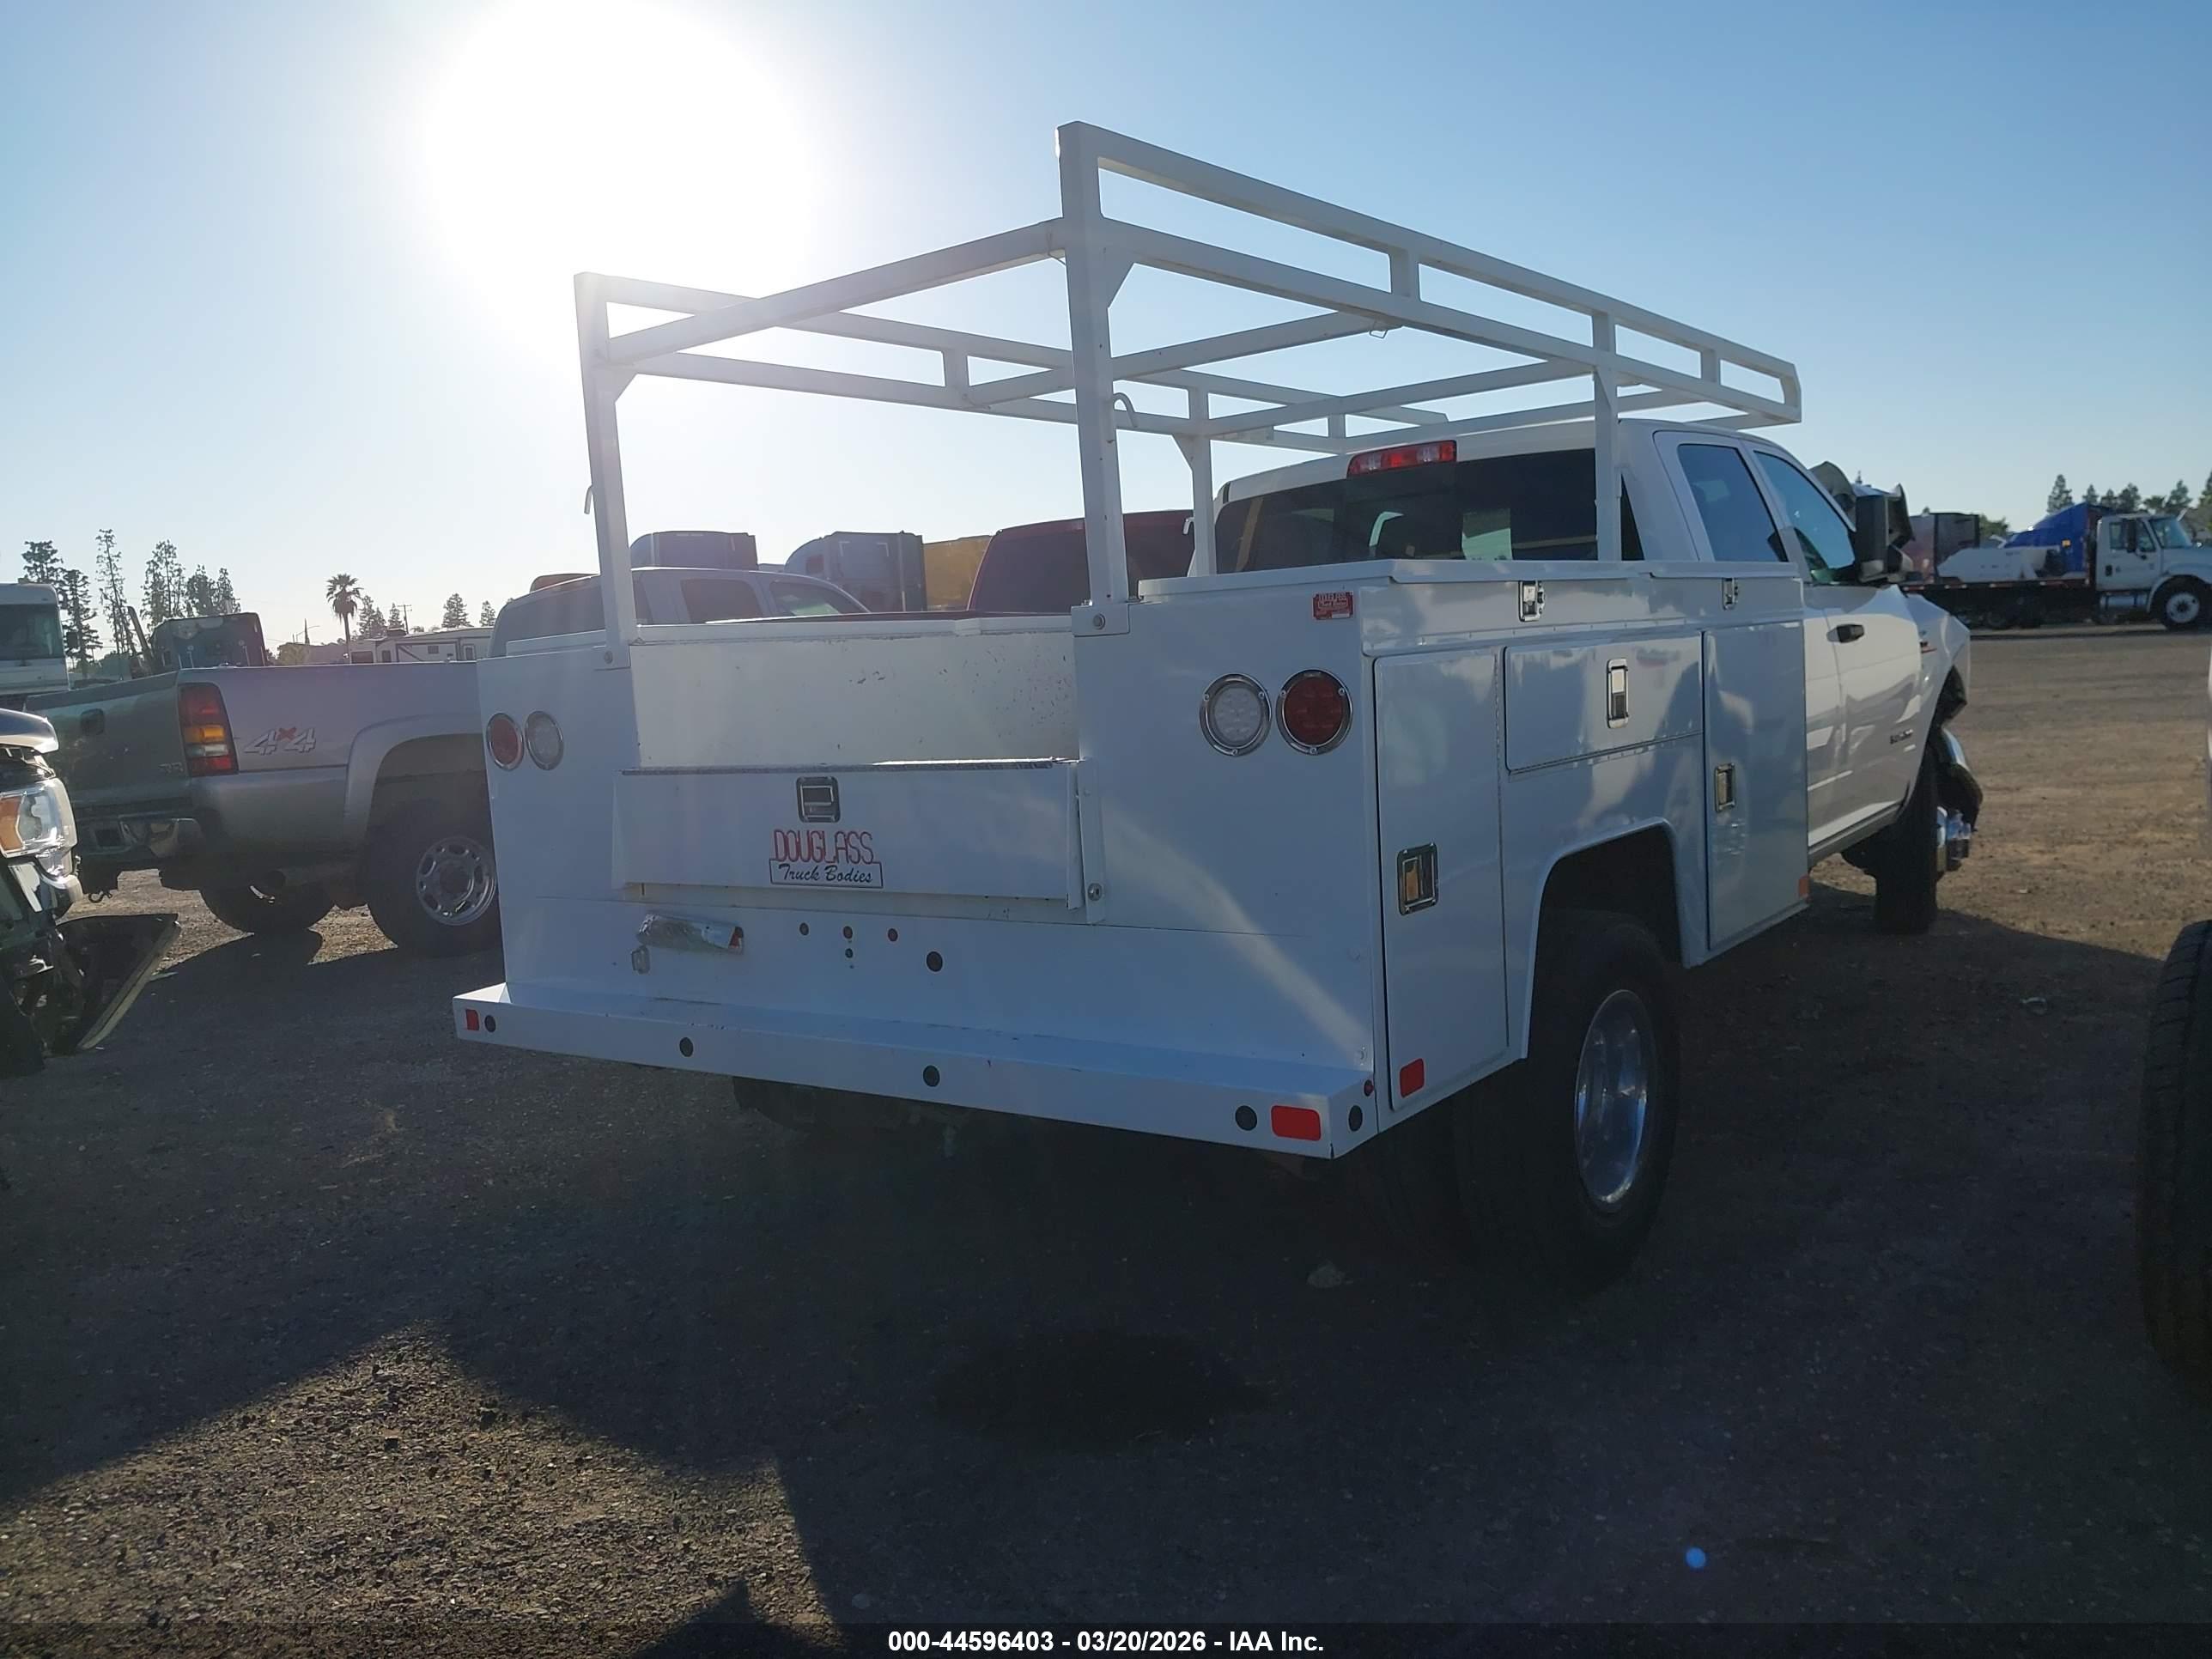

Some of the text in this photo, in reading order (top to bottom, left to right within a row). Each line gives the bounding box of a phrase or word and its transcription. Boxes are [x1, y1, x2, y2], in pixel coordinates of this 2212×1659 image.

[774, 830, 872, 865] DOUGLASS
[778, 863, 873, 884] Truck Bodies
